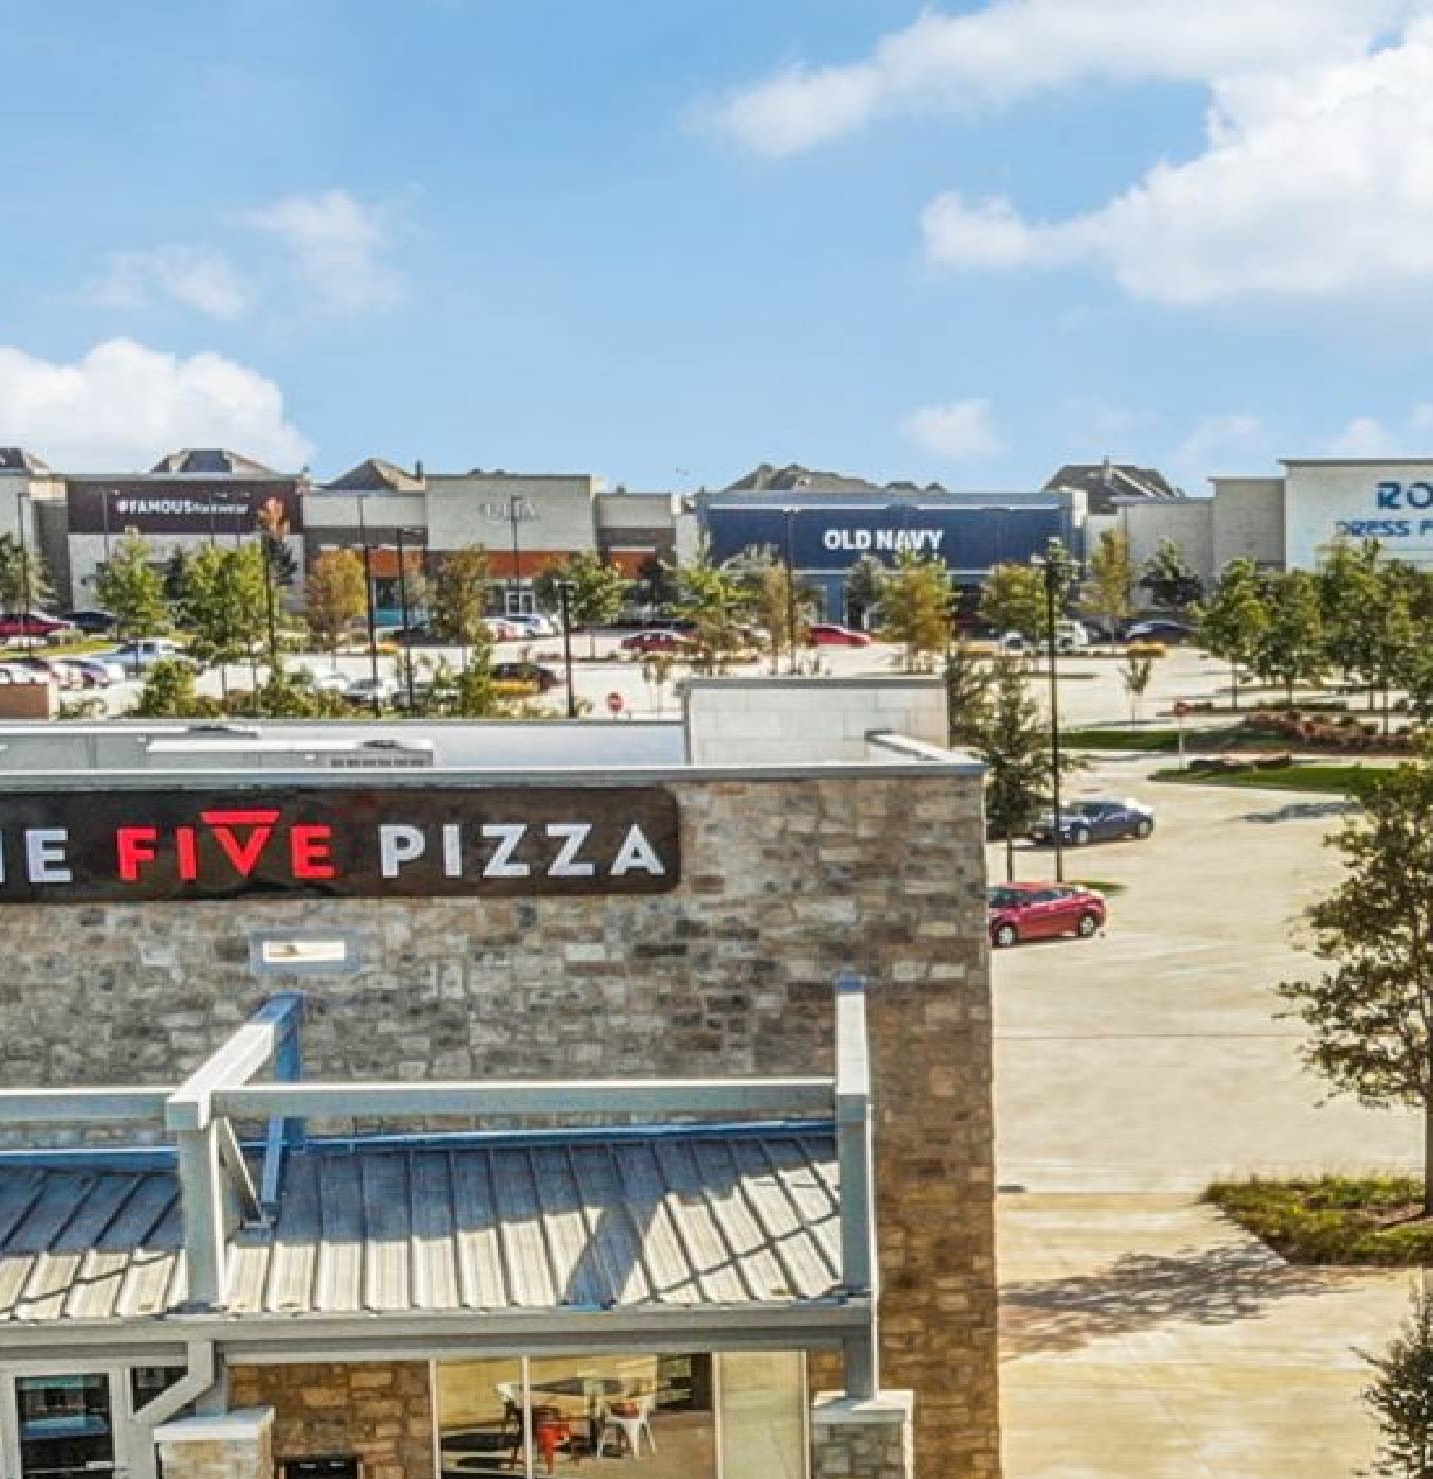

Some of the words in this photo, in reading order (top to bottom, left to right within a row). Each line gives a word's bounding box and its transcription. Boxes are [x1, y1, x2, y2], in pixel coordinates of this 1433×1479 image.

[823, 529, 872, 550] OLD
[876, 529, 944, 551] NAVY
[115, 810, 336, 881] FIVE
[378, 823, 666, 879] PIZZA
